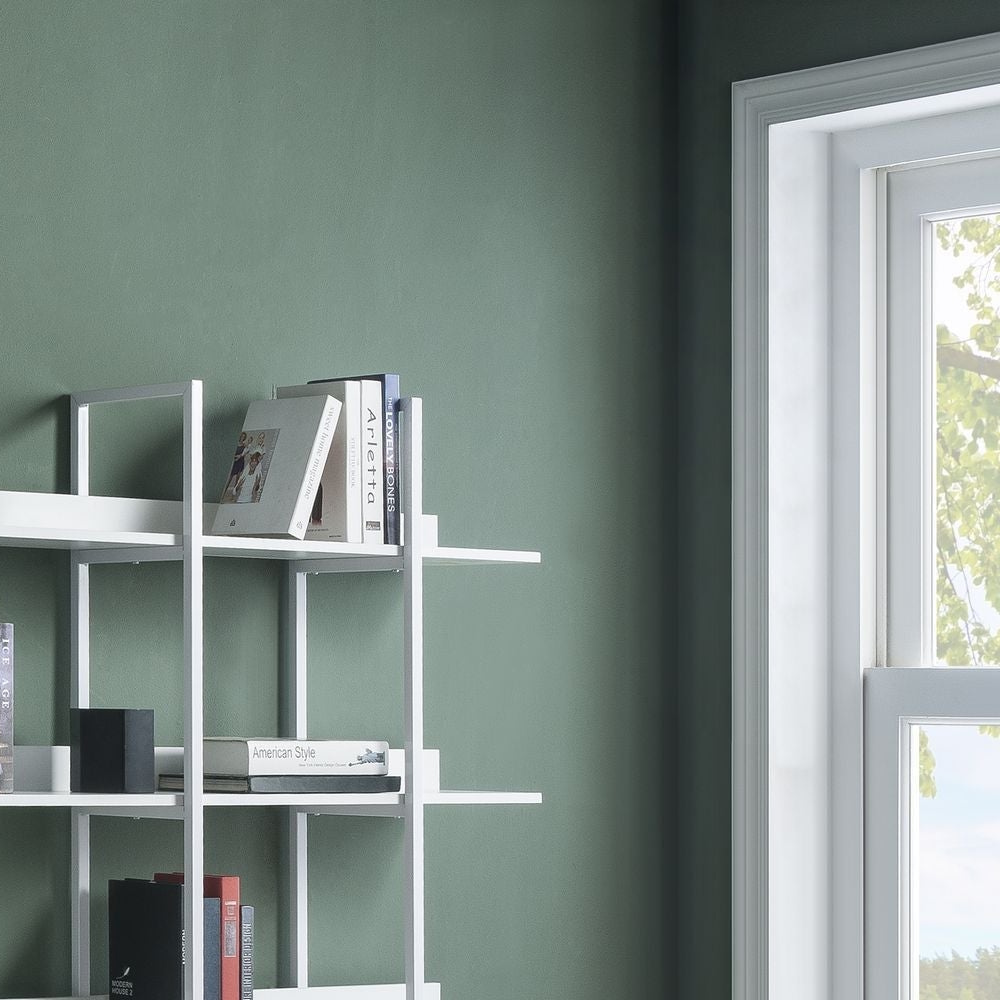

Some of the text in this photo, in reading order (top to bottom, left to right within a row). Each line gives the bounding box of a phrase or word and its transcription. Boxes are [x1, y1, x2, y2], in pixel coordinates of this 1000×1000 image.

[304, 407, 334, 501] sweet home magazine
[366, 408, 378, 504] Arletta
[386, 411, 394, 464] LOVELY
[386, 466, 395, 512] BONES
[1, 638, 9, 709] ICE AGE
[252, 745, 316, 761] American Style
[243, 923, 252, 951] DESIGN
[111, 979, 133, 988] MODERN
[243, 953, 252, 987] INTERIOR
[111, 987, 128, 996] HOUSE
